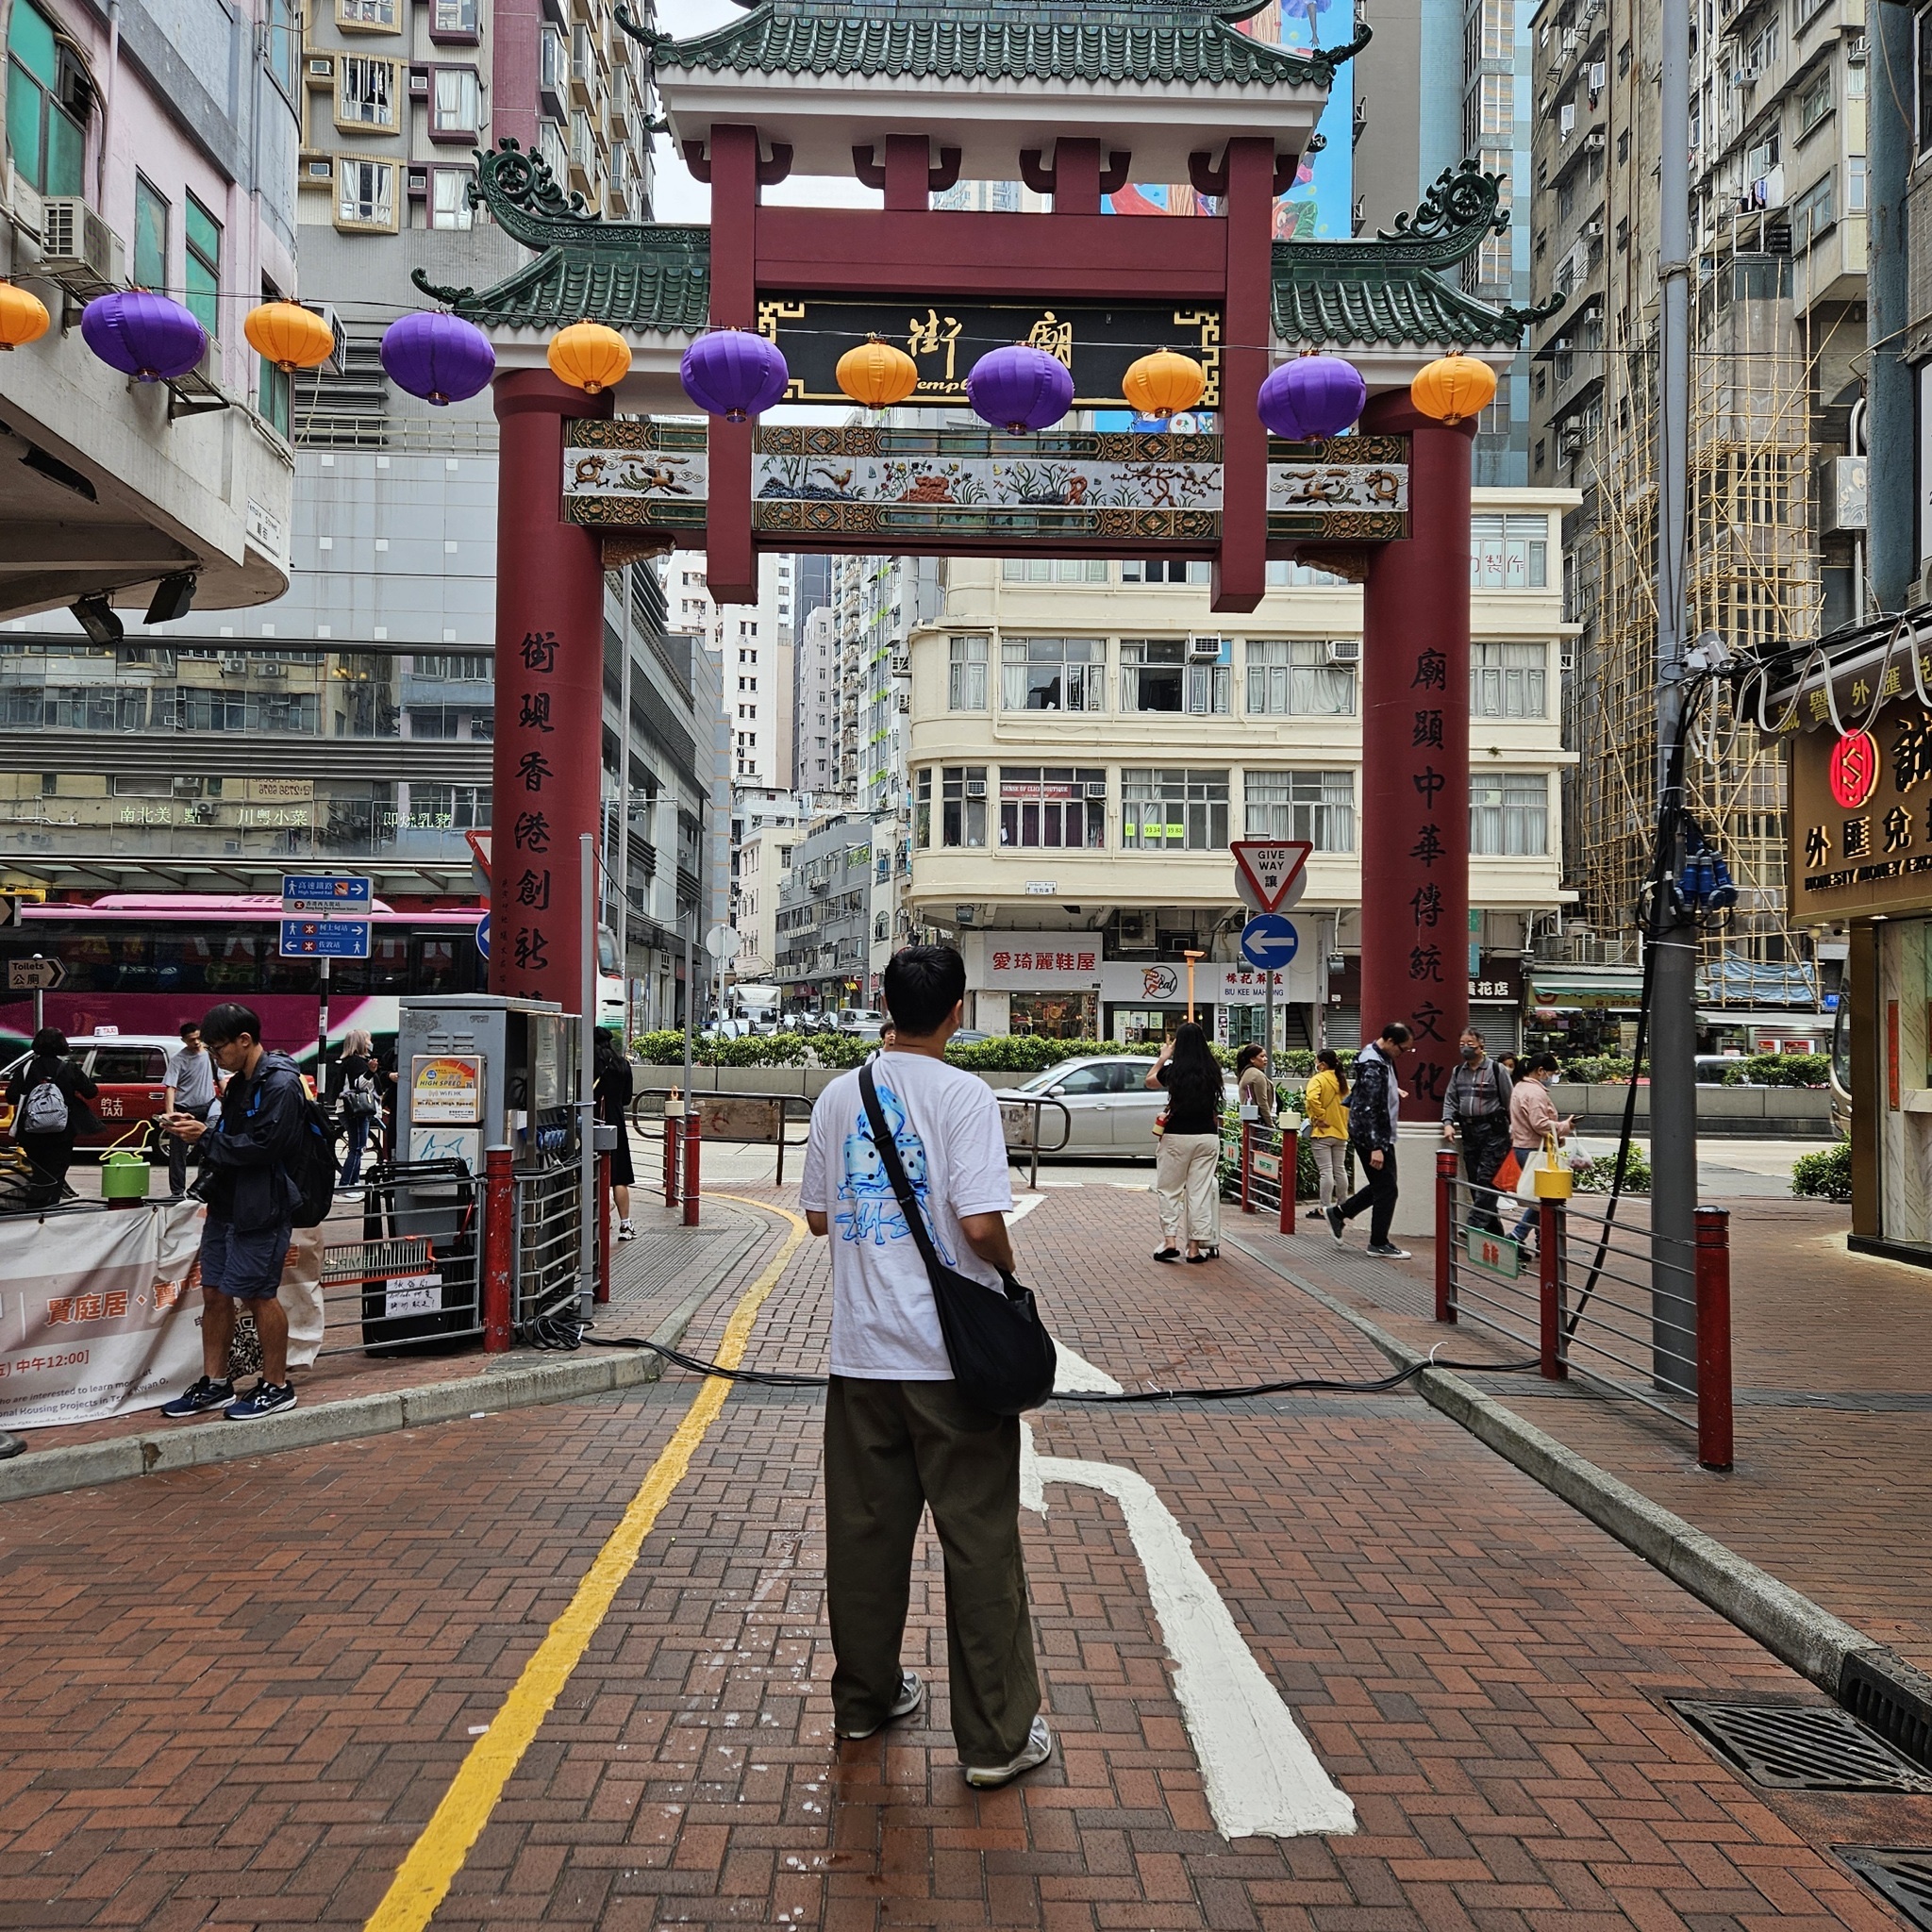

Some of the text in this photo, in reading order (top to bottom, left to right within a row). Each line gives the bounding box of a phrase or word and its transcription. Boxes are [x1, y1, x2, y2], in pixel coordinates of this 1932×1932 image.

[513, 630, 560, 1000] 街現香港創新
[1806, 799, 1932, 869] 外匯兌
[1257, 850, 1285, 859] GIVE
[1258, 861, 1284, 871] WAY
[1805, 854, 1932, 891] HONESTY MONEY EXC
[1265, 874, 1278, 888] 讓
[1409, 647, 1447, 1105] 廟顯中華傳統文化
[298, 881, 333, 891] 高速鐵路
[12, 962, 44, 971] Toilets
[992, 952, 1096, 971] 愛琦麗鞋屋
[1253, 989, 1284, 997] MAHONG
[101, 1097, 123, 1108] 的士
[101, 1108, 123, 1117] TAXI
[47, 1291, 130, 1328] 賢庭居
[12, 1395, 28, 1404] are
[30, 1388, 76, 1401] interested
[77, 1386, 88, 1395] to
[90, 1382, 113, 1393] learn
[20, 1404, 58, 1416] Housing
[60, 1399, 98, 1411] Projects
[100, 1396, 109, 1405] in
[134, 1381, 158, 1393] Kwan
